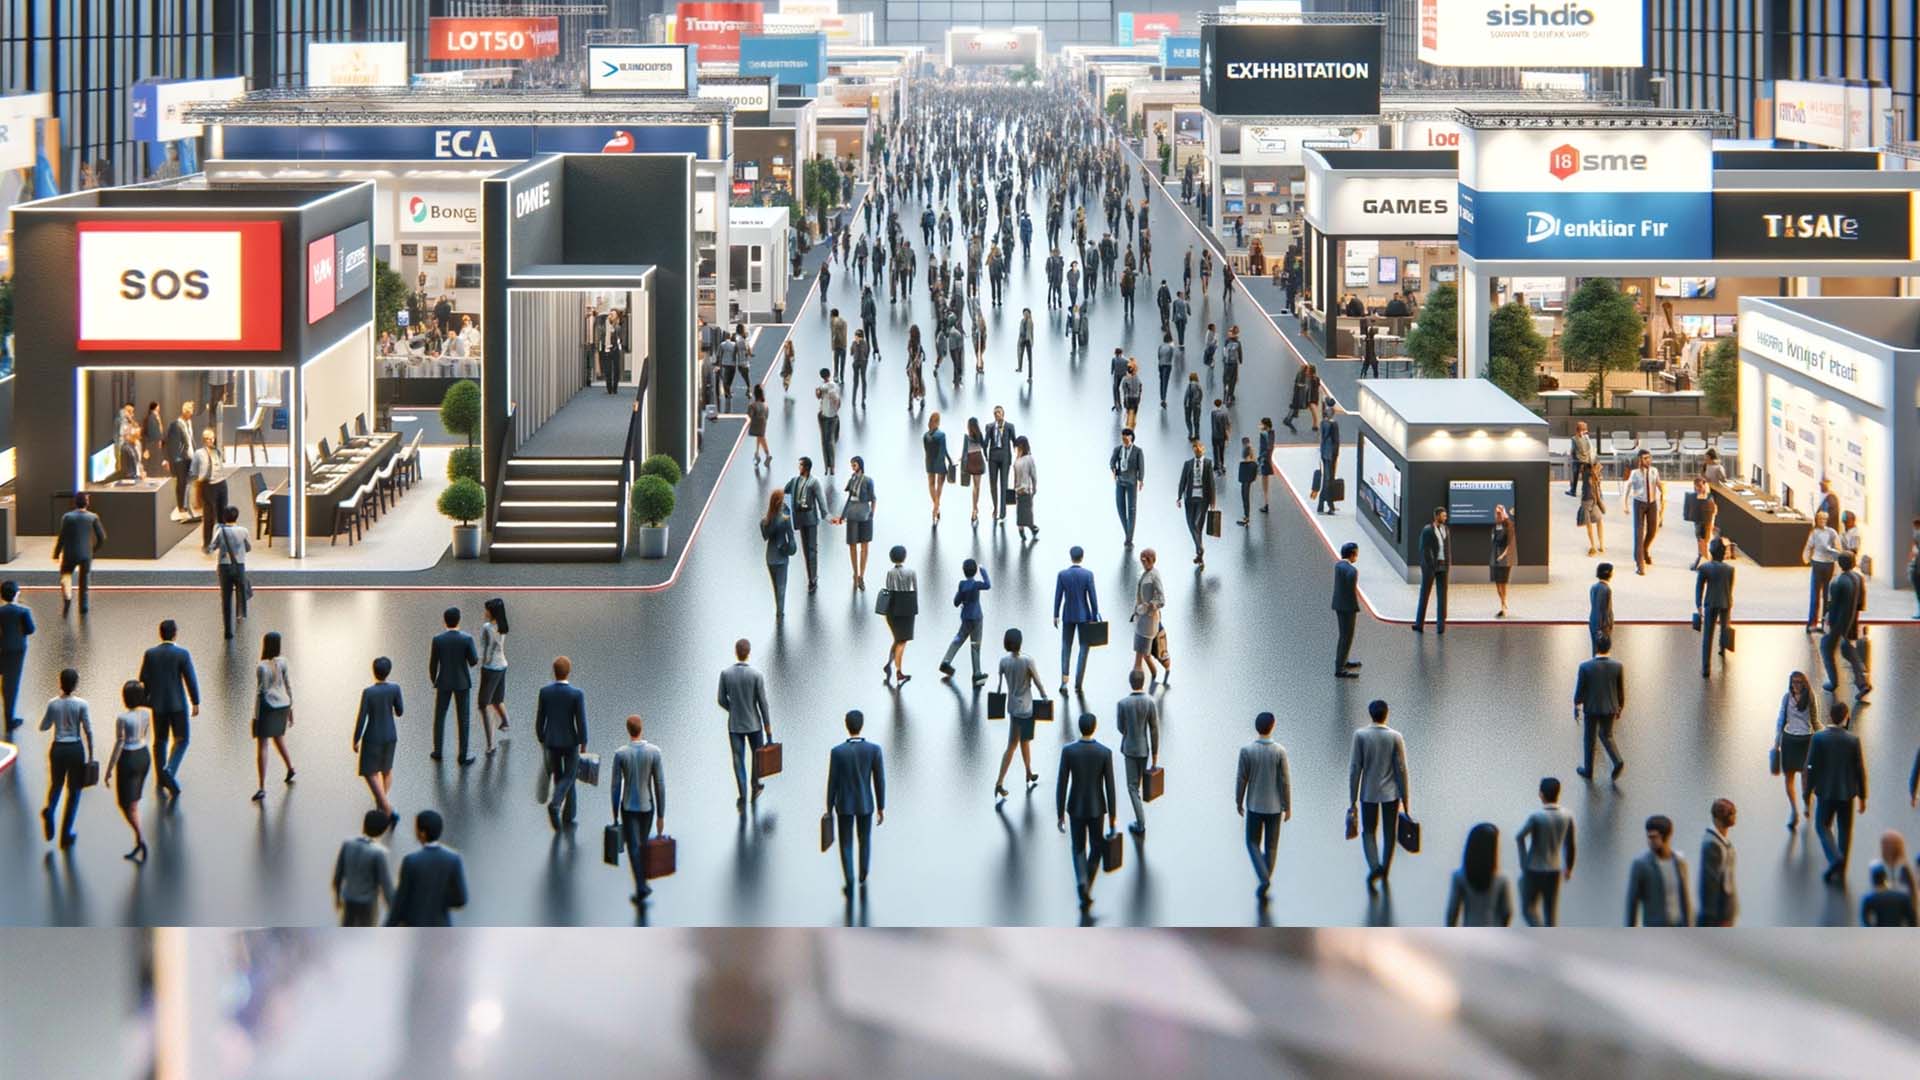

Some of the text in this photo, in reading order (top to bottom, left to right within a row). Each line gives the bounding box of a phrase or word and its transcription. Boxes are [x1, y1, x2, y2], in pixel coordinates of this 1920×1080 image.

[1487, 3, 1595, 26] sishdio
[435, 130, 498, 158] ECA
[1583, 152, 1648, 172] sme
[1363, 199, 1448, 214] GAMES
[120, 269, 209, 300] SOS
